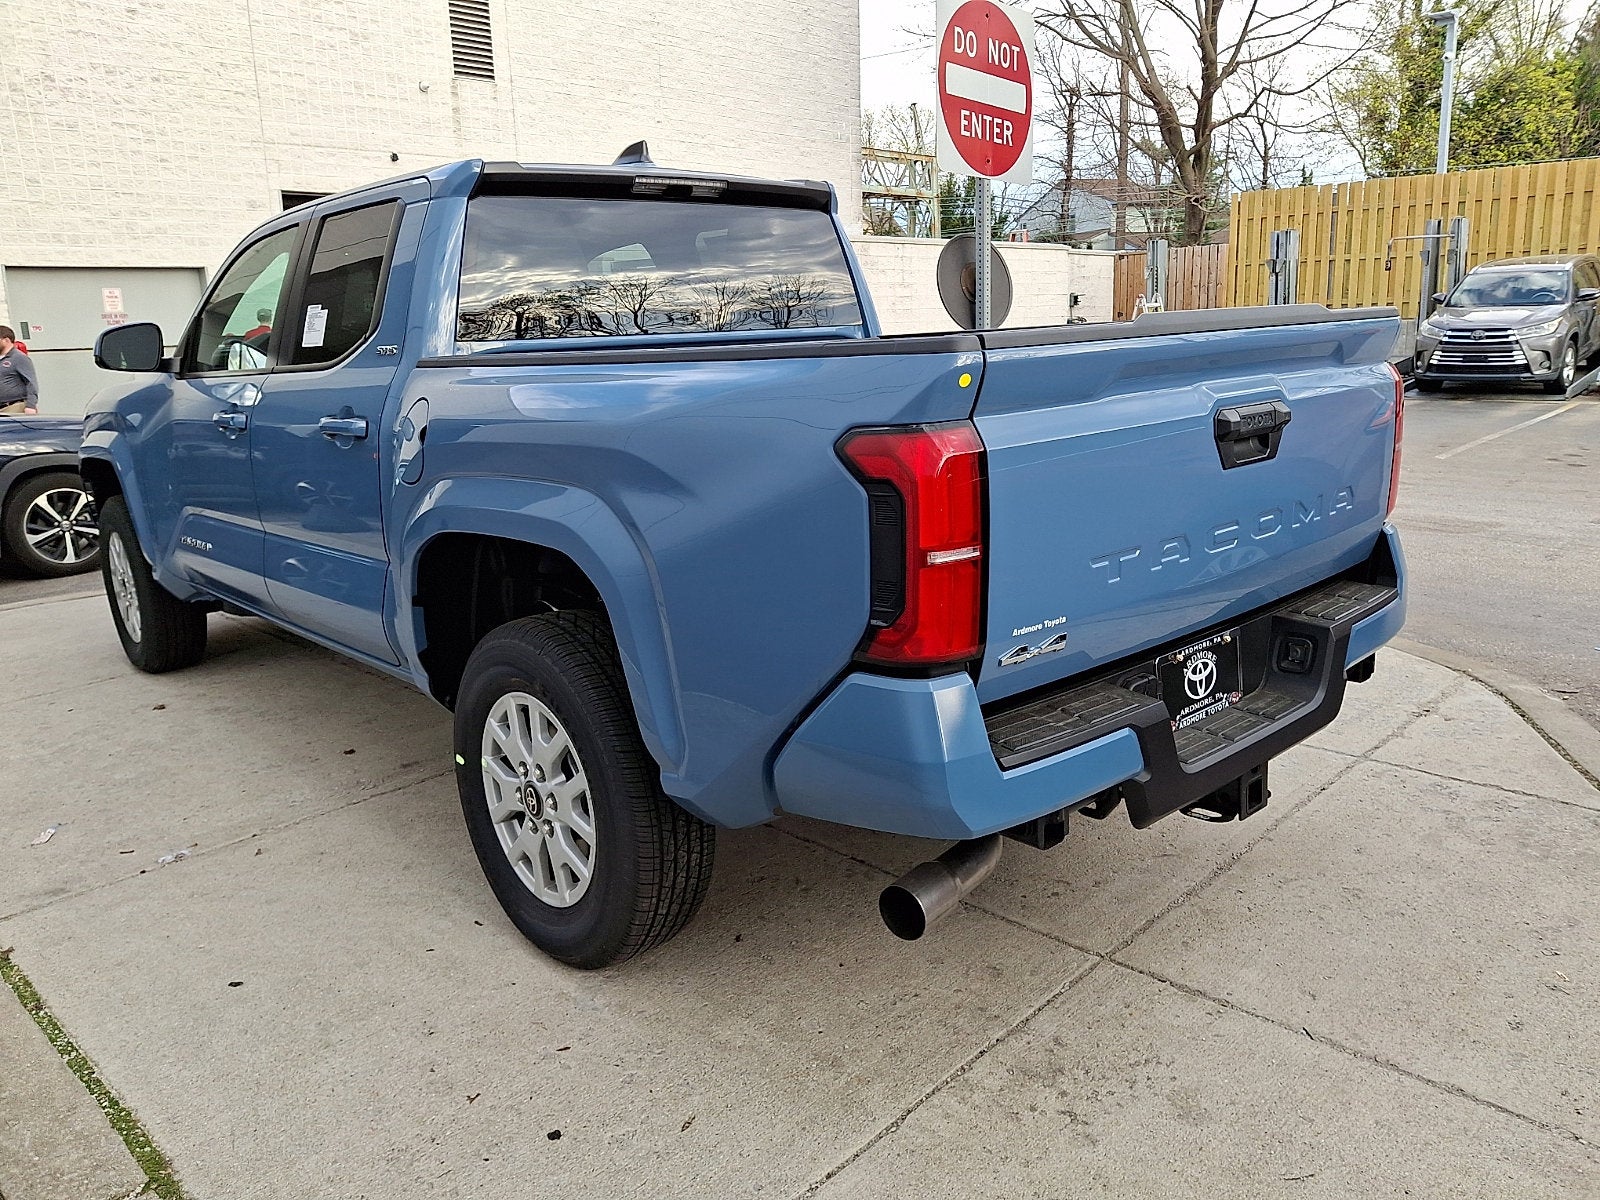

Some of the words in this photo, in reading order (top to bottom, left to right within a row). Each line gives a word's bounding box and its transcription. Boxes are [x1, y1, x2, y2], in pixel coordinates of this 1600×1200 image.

[953, 25, 977, 58] DO
[987, 37, 1021, 72] NOT
[959, 109, 1014, 147] ENTER
[1240, 412, 1274, 430] TOYOTA
[1088, 485, 1355, 585] TACOMA
[1012, 623, 1043, 637] Ardmore
[1043, 616, 1067, 628] Toyota
[1213, 636, 1222, 645] PA
[1183, 650, 1218, 677] ARDMORE
[1178, 711, 1207, 729] ARDMORE
[1207, 701, 1230, 717] TOYOTA
[1180, 696, 1215, 716] ARDMORE,
[1215, 691, 1224, 701] PA
